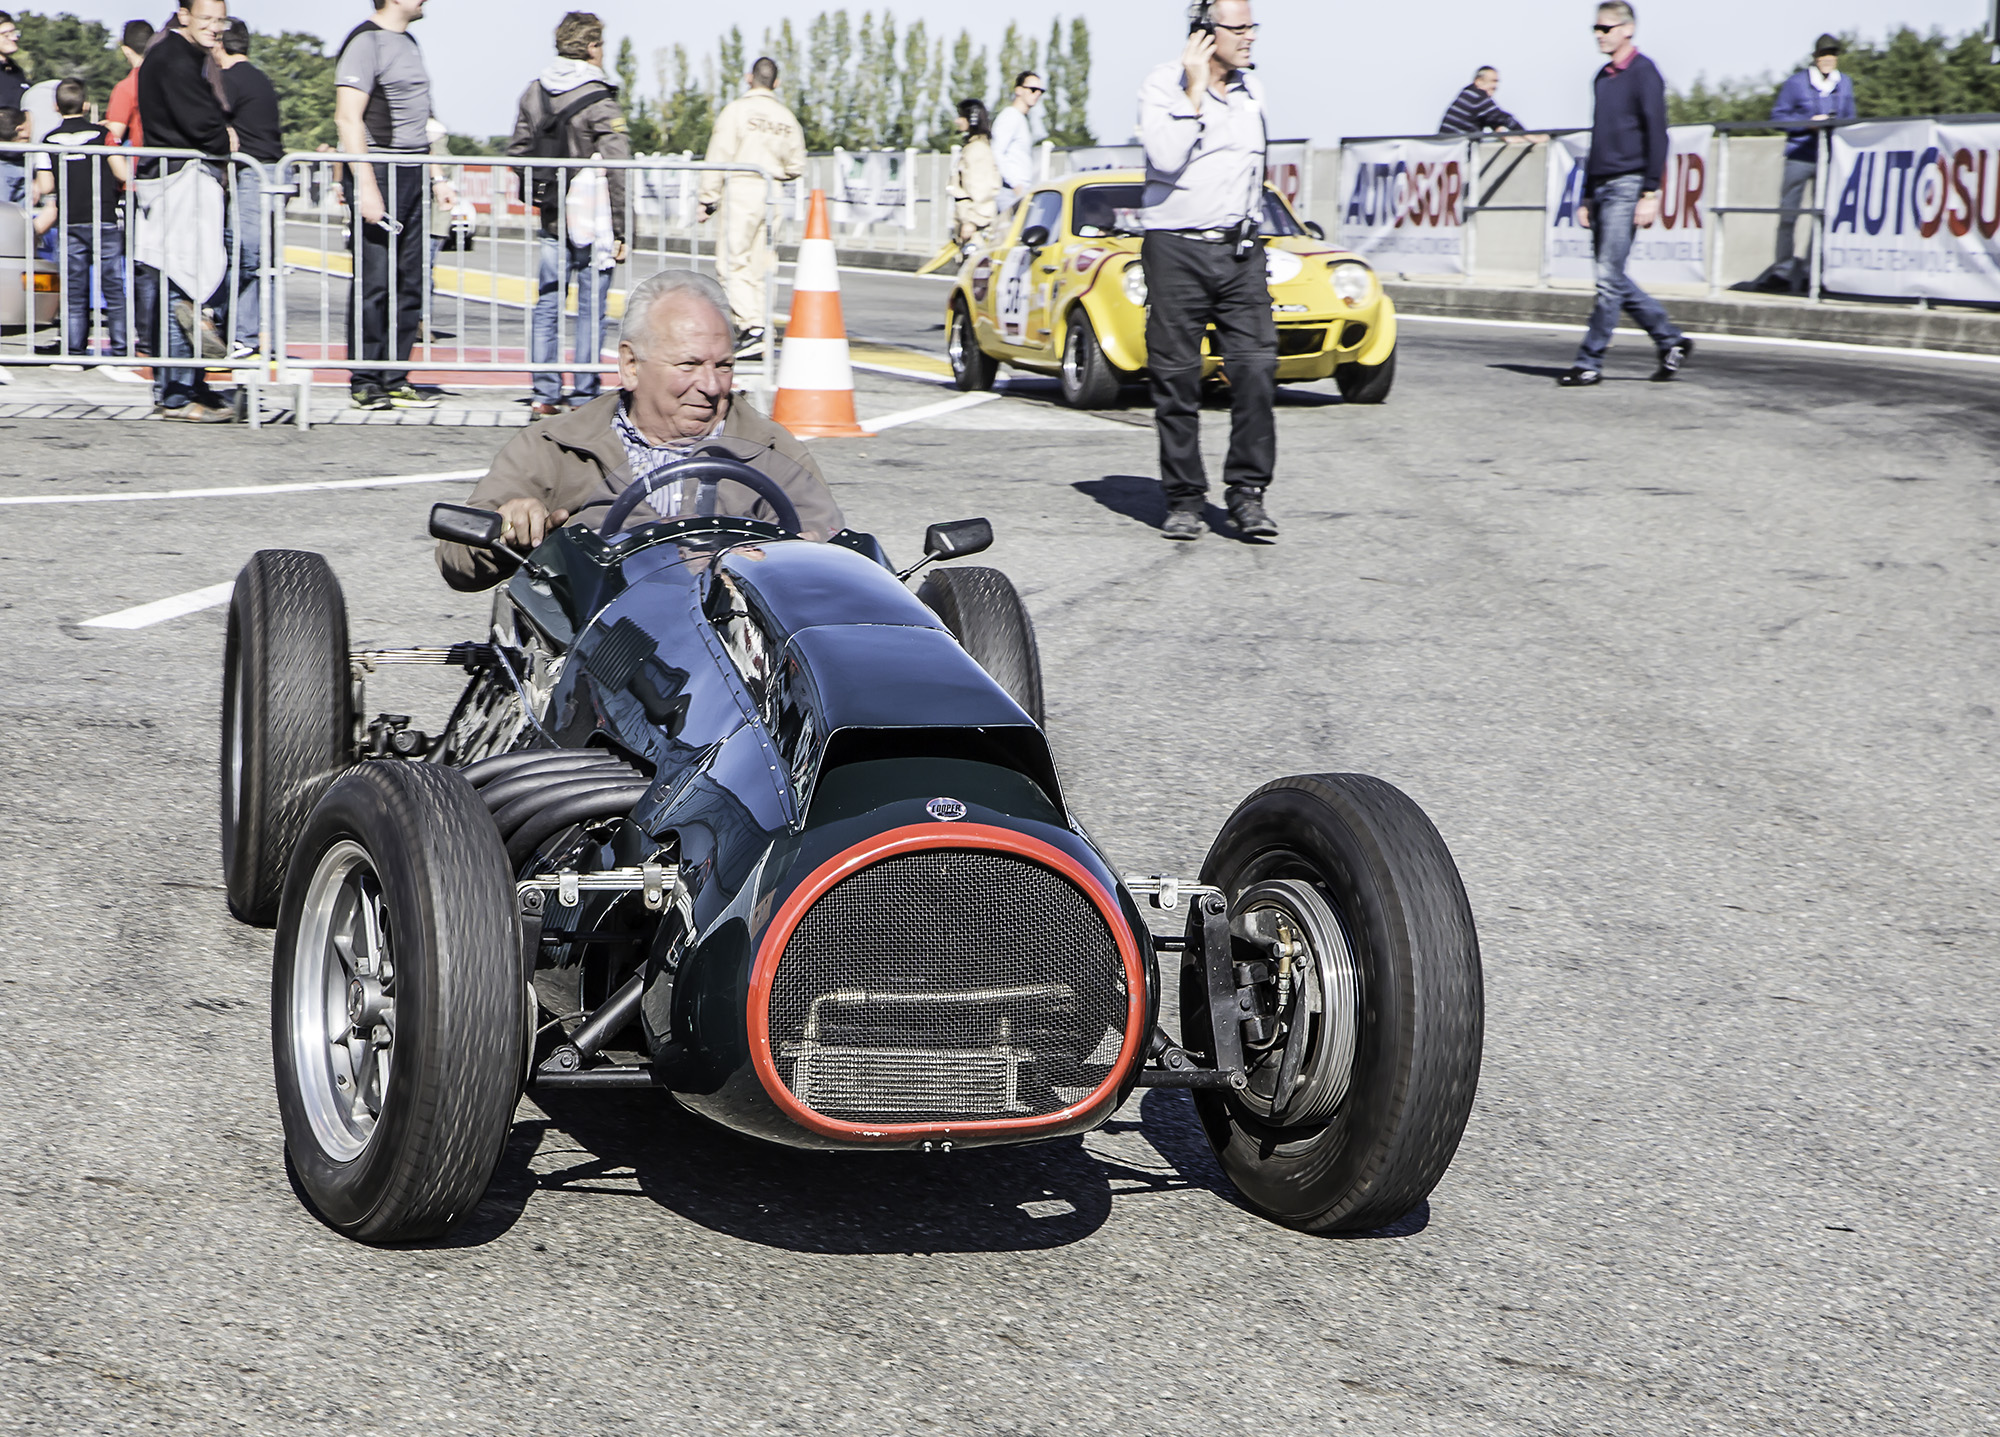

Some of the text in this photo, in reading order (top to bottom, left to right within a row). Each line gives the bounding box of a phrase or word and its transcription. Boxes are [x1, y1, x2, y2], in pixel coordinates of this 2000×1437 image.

[747, 116, 792, 137] STAFF
[1344, 160, 1462, 229] AUTOSUR
[931, 804, 961, 813] COOPER
